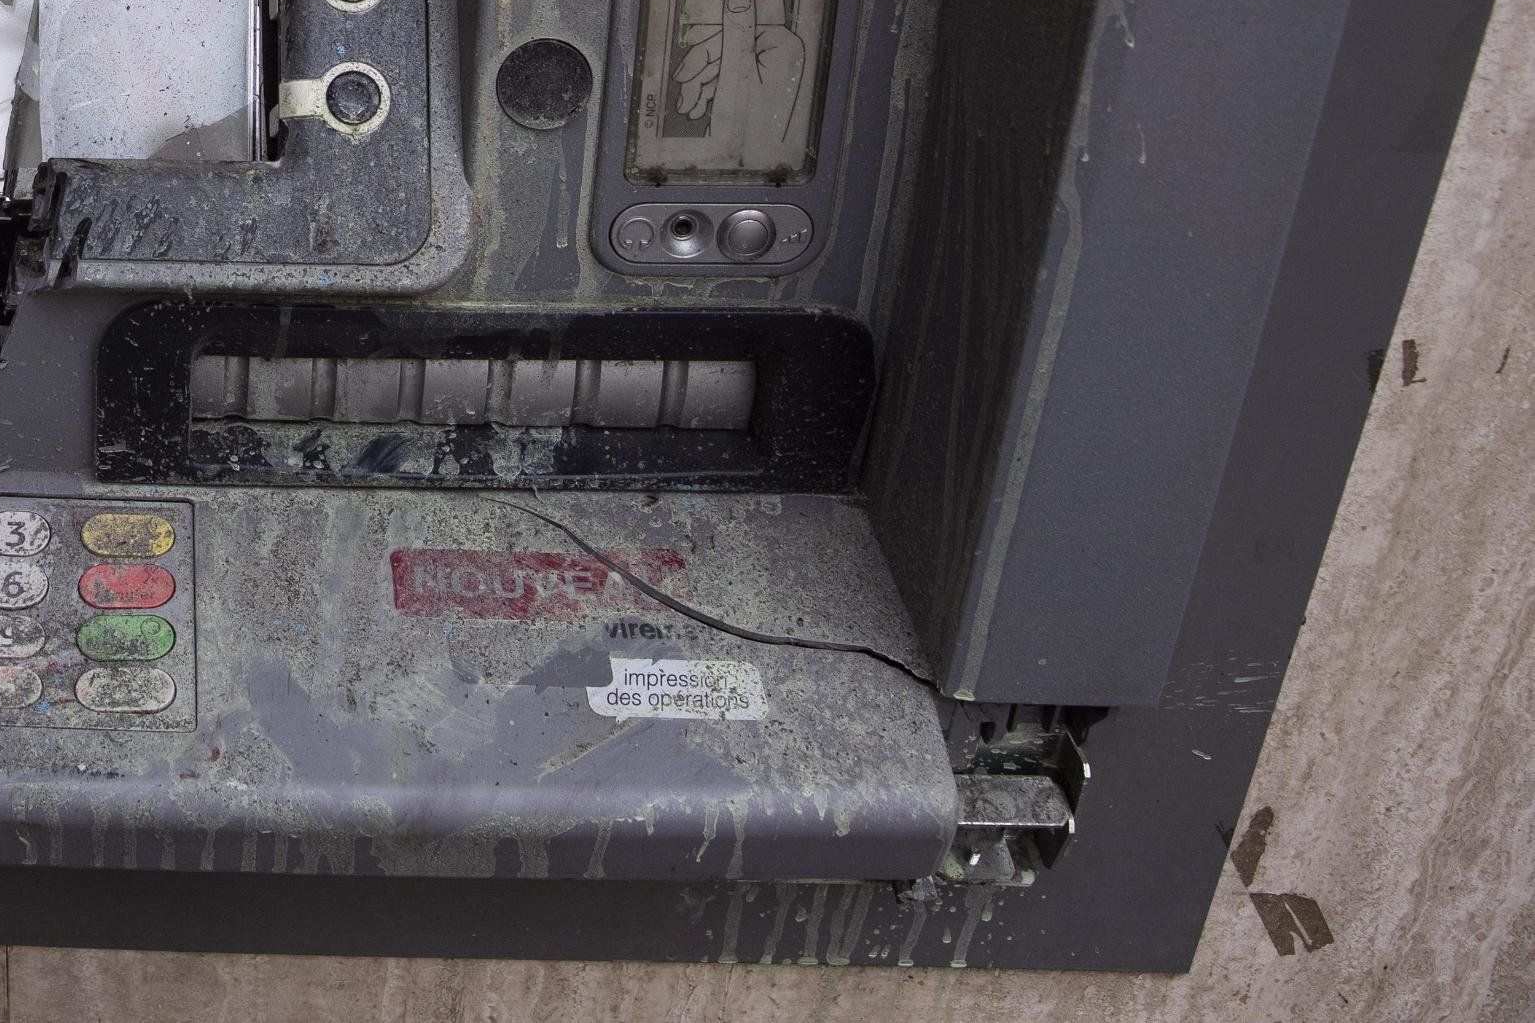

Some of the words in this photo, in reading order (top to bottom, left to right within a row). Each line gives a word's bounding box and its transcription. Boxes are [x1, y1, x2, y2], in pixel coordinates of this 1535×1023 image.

[5, 521, 26, 547] 3
[1, 571, 25, 598] 6
[623, 668, 728, 690] impression
[606, 687, 642, 707] des
[647, 689, 750, 711] opérations
